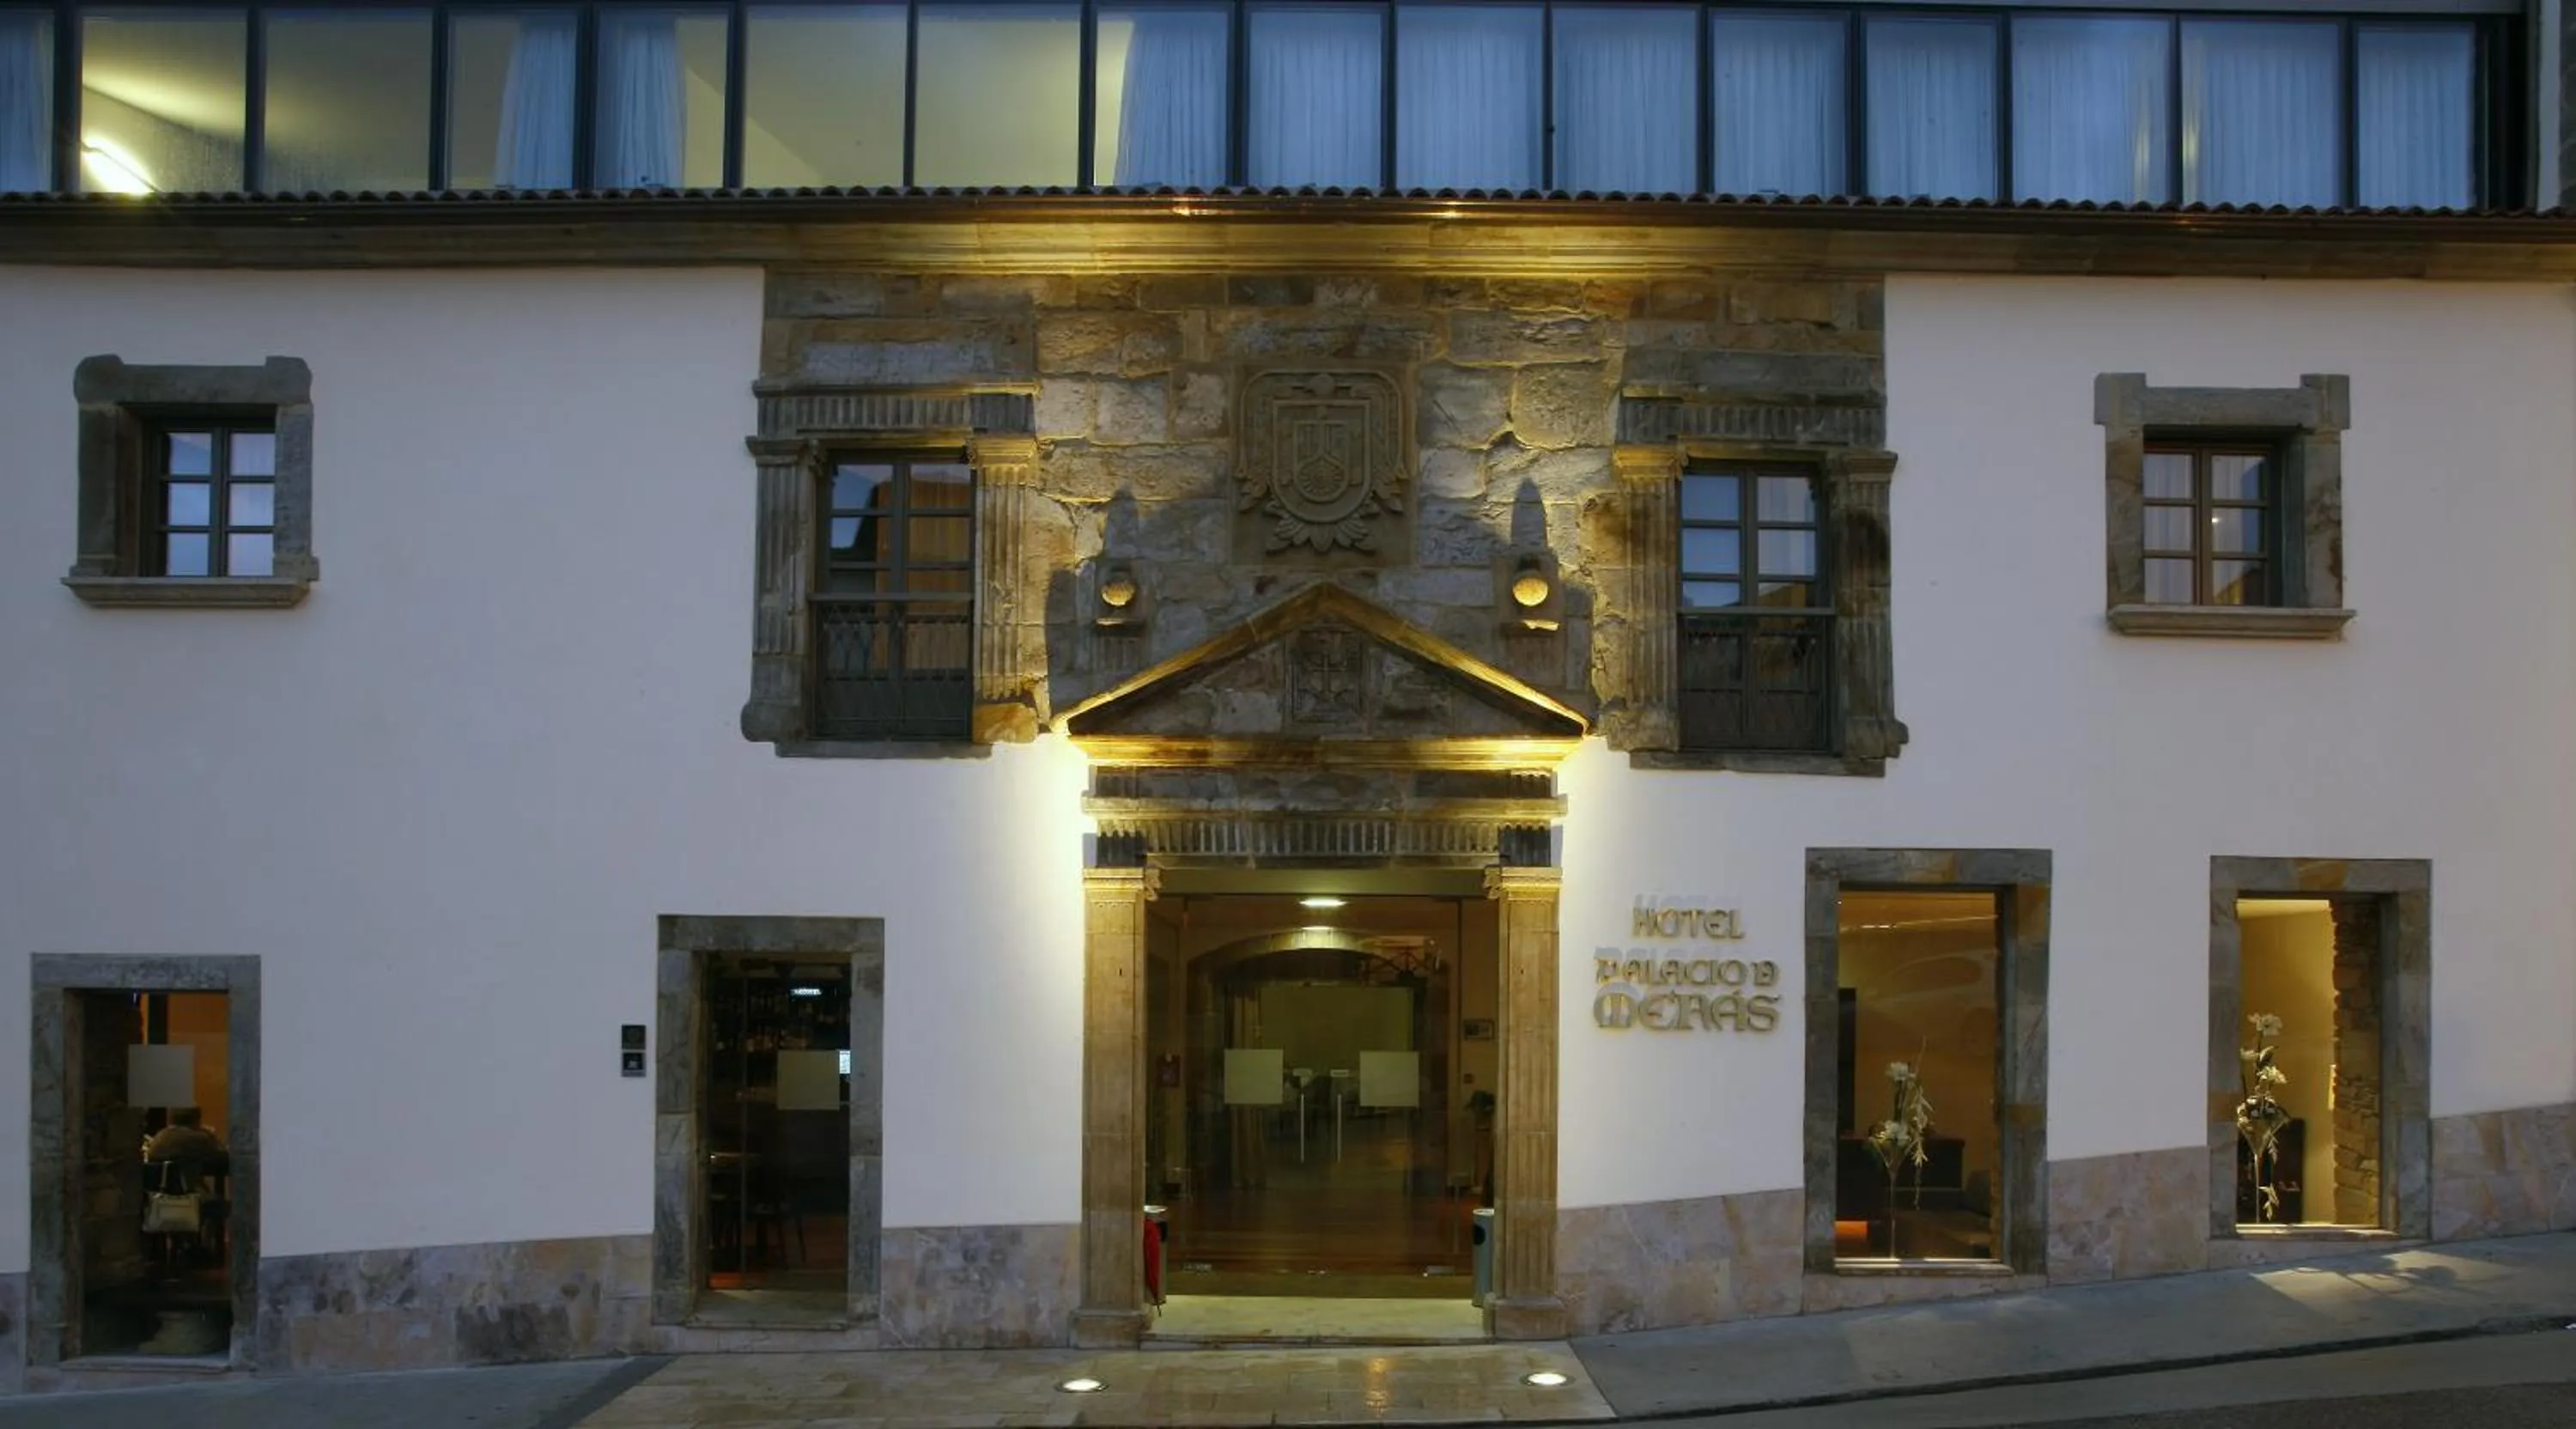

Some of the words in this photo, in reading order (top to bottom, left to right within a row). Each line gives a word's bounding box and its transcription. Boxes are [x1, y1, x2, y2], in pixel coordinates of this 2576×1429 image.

[1633, 908, 1744, 939] HOTEL
[1595, 958, 1748, 986] PALACIO
[1593, 989, 1782, 1031] MERÁS
